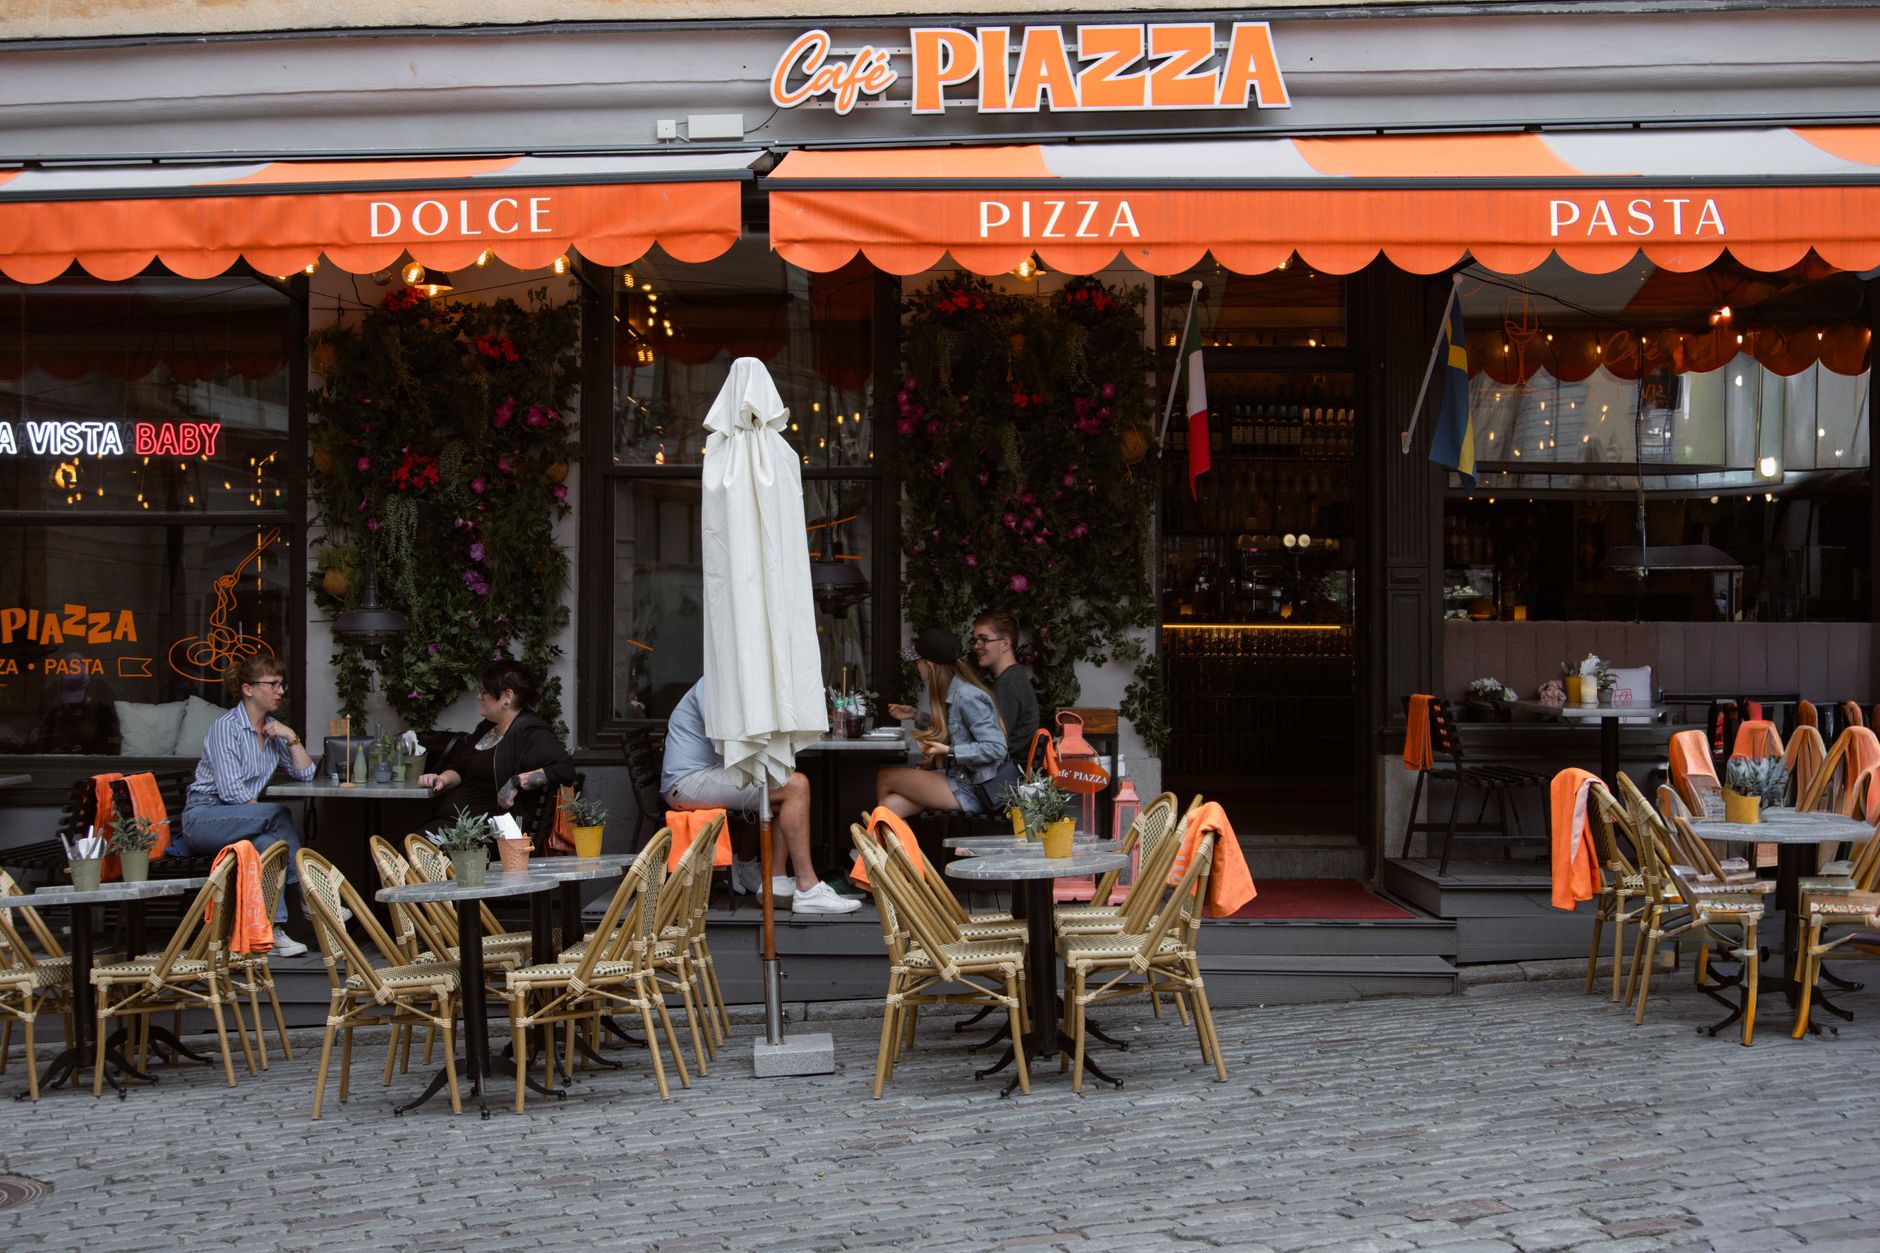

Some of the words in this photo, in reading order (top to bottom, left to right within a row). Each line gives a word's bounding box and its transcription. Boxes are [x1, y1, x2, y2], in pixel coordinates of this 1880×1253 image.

[770, 29, 898, 116] Café
[910, 21, 1292, 115] PIAZZA
[370, 197, 553, 238] DOLCE
[979, 201, 1141, 238] PIZZA
[1550, 198, 1726, 237] PASTA
[27, 421, 124, 456] VISTA
[135, 422, 221, 457] BABY
[0, 602, 139, 646] PIAZZA
[44, 658, 105, 676] PASTA
[1073, 770, 1108, 785] PIAZZA
